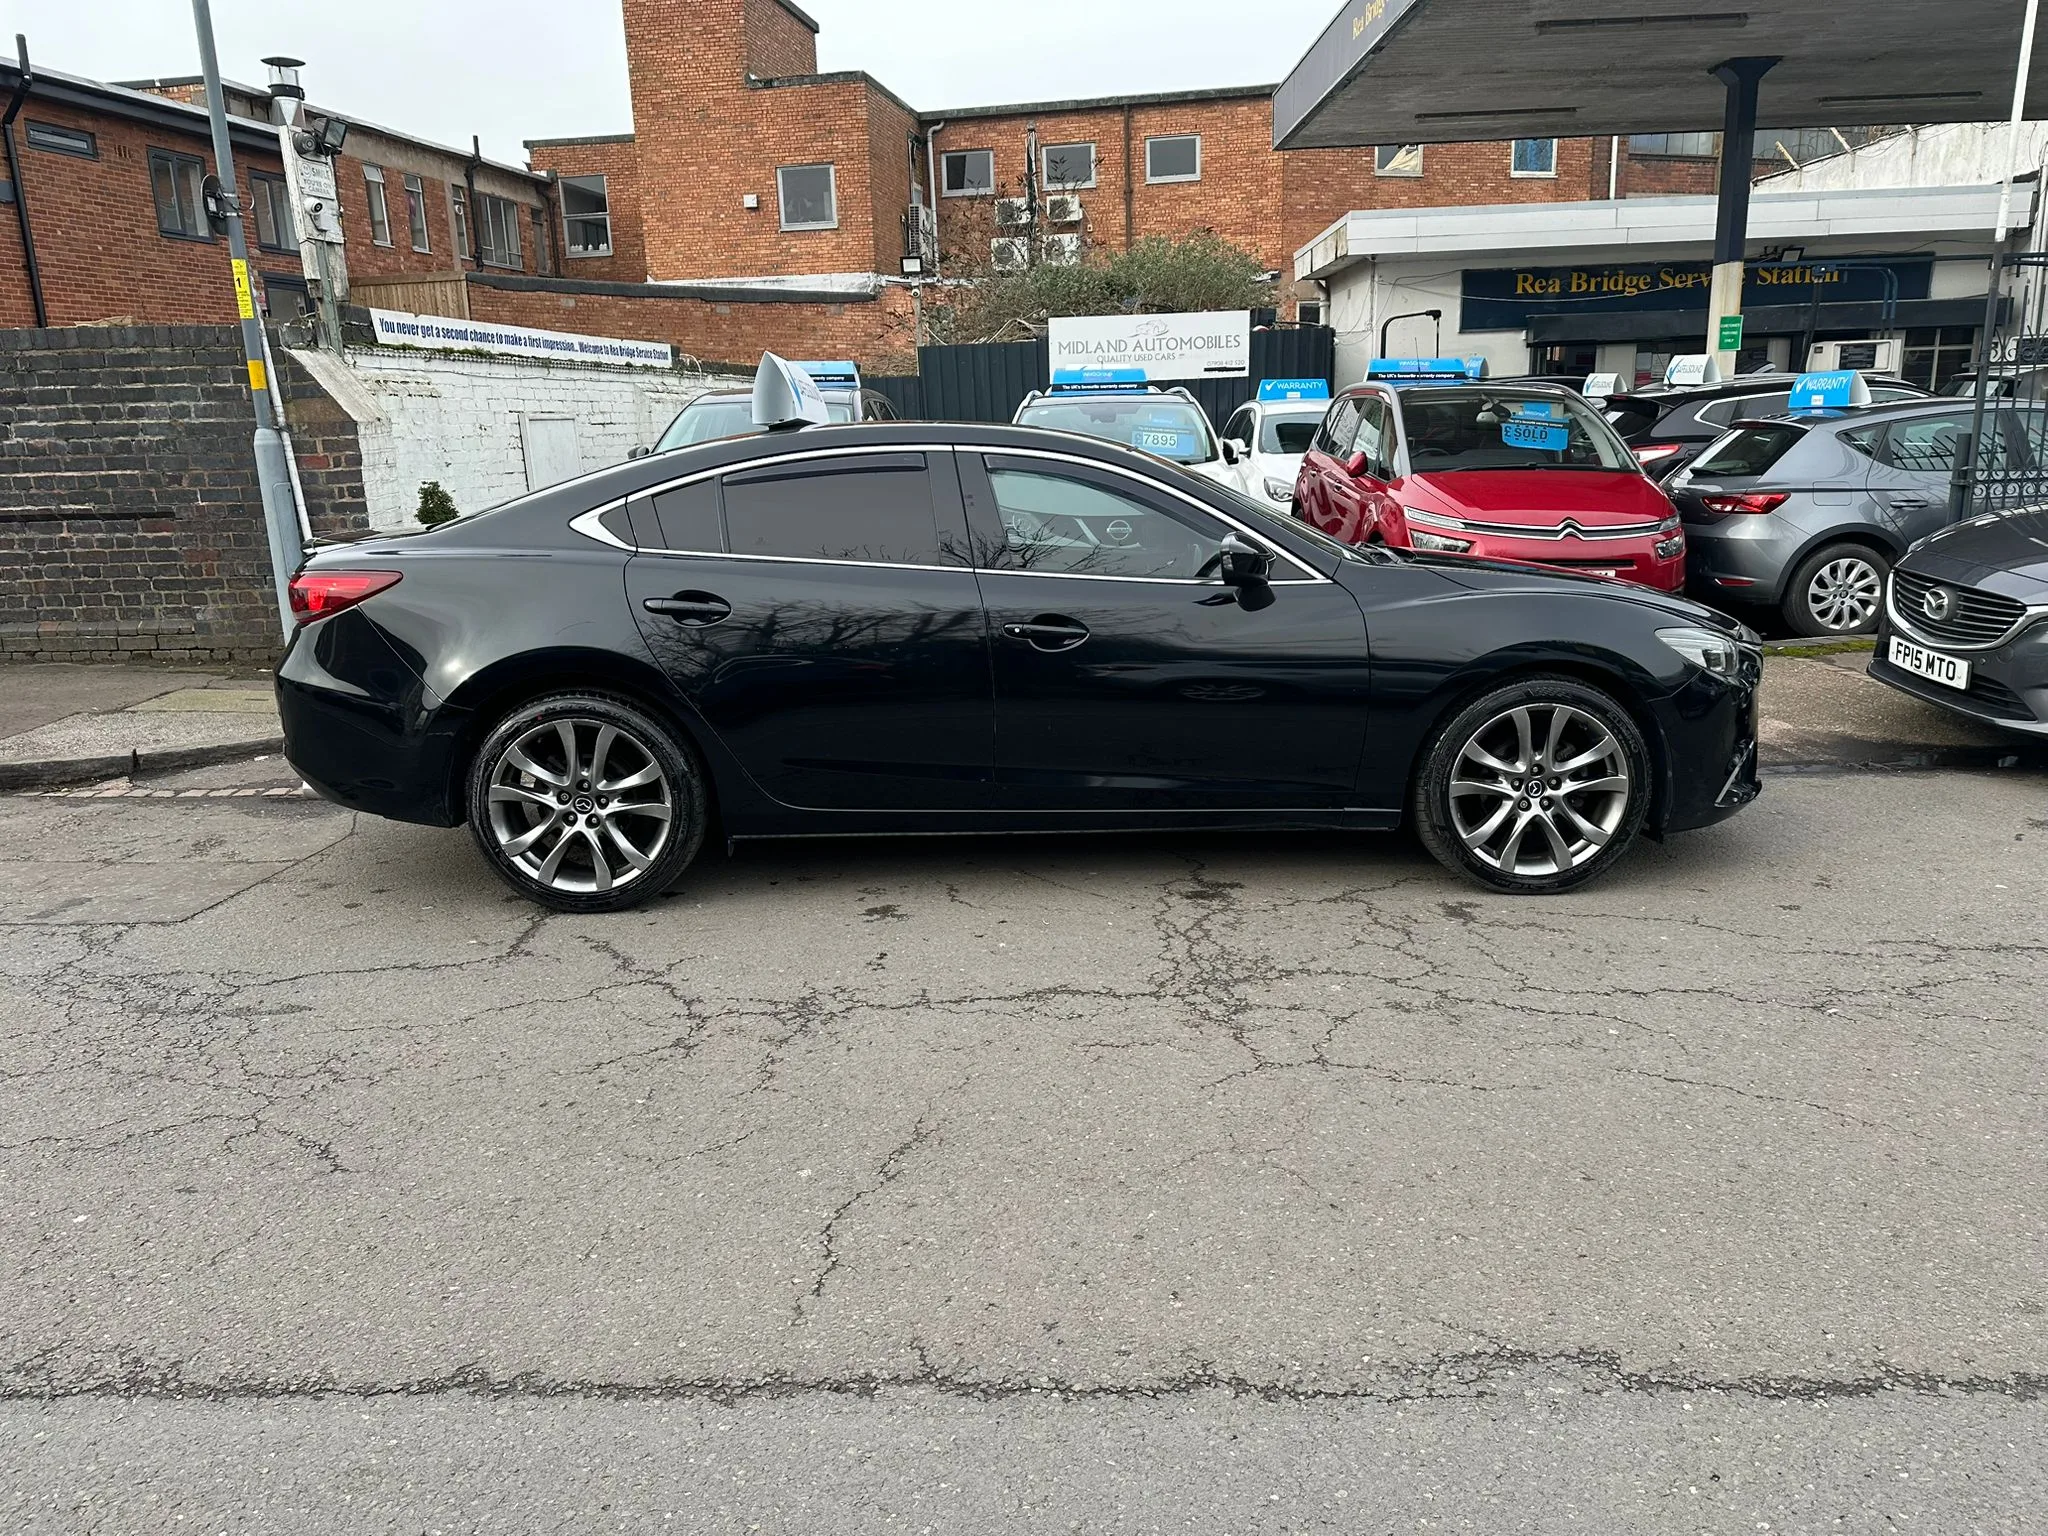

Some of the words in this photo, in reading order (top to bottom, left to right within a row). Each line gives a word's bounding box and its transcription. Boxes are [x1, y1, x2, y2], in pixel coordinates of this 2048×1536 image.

[236, 277, 241, 288] 1
[1515, 273, 1560, 294] Rea
[1569, 270, 1651, 296] Bridge
[379, 317, 395, 334] You
[396, 321, 419, 337] never
[420, 325, 435, 338] get
[435, 326, 440, 338] a
[441, 327, 468, 341] second
[469, 328, 495, 344] chance
[496, 331, 503, 344] to
[504, 333, 522, 347] make
[523, 336, 527, 347] a
[528, 335, 542, 348] first
[578, 341, 603, 354] Welcome
[603, 344, 609, 355] to
[619, 345, 635, 358] Bridge
[636, 346, 652, 359] Service
[653, 348, 668, 360] Station
[1058, 339, 1128, 355] MIDLAND
[1132, 334, 1241, 352] AUTOMOBILES
[1096, 354, 1132, 363] QUALITY
[1134, 354, 1153, 362] USED
[1155, 353, 1176, 361] CARS
[1276, 381, 1323, 390] WARRANTY
[1806, 376, 1849, 390] WARRANTY
[1896, 641, 1923, 670] FP15
[1926, 653, 1956, 681] MTO
